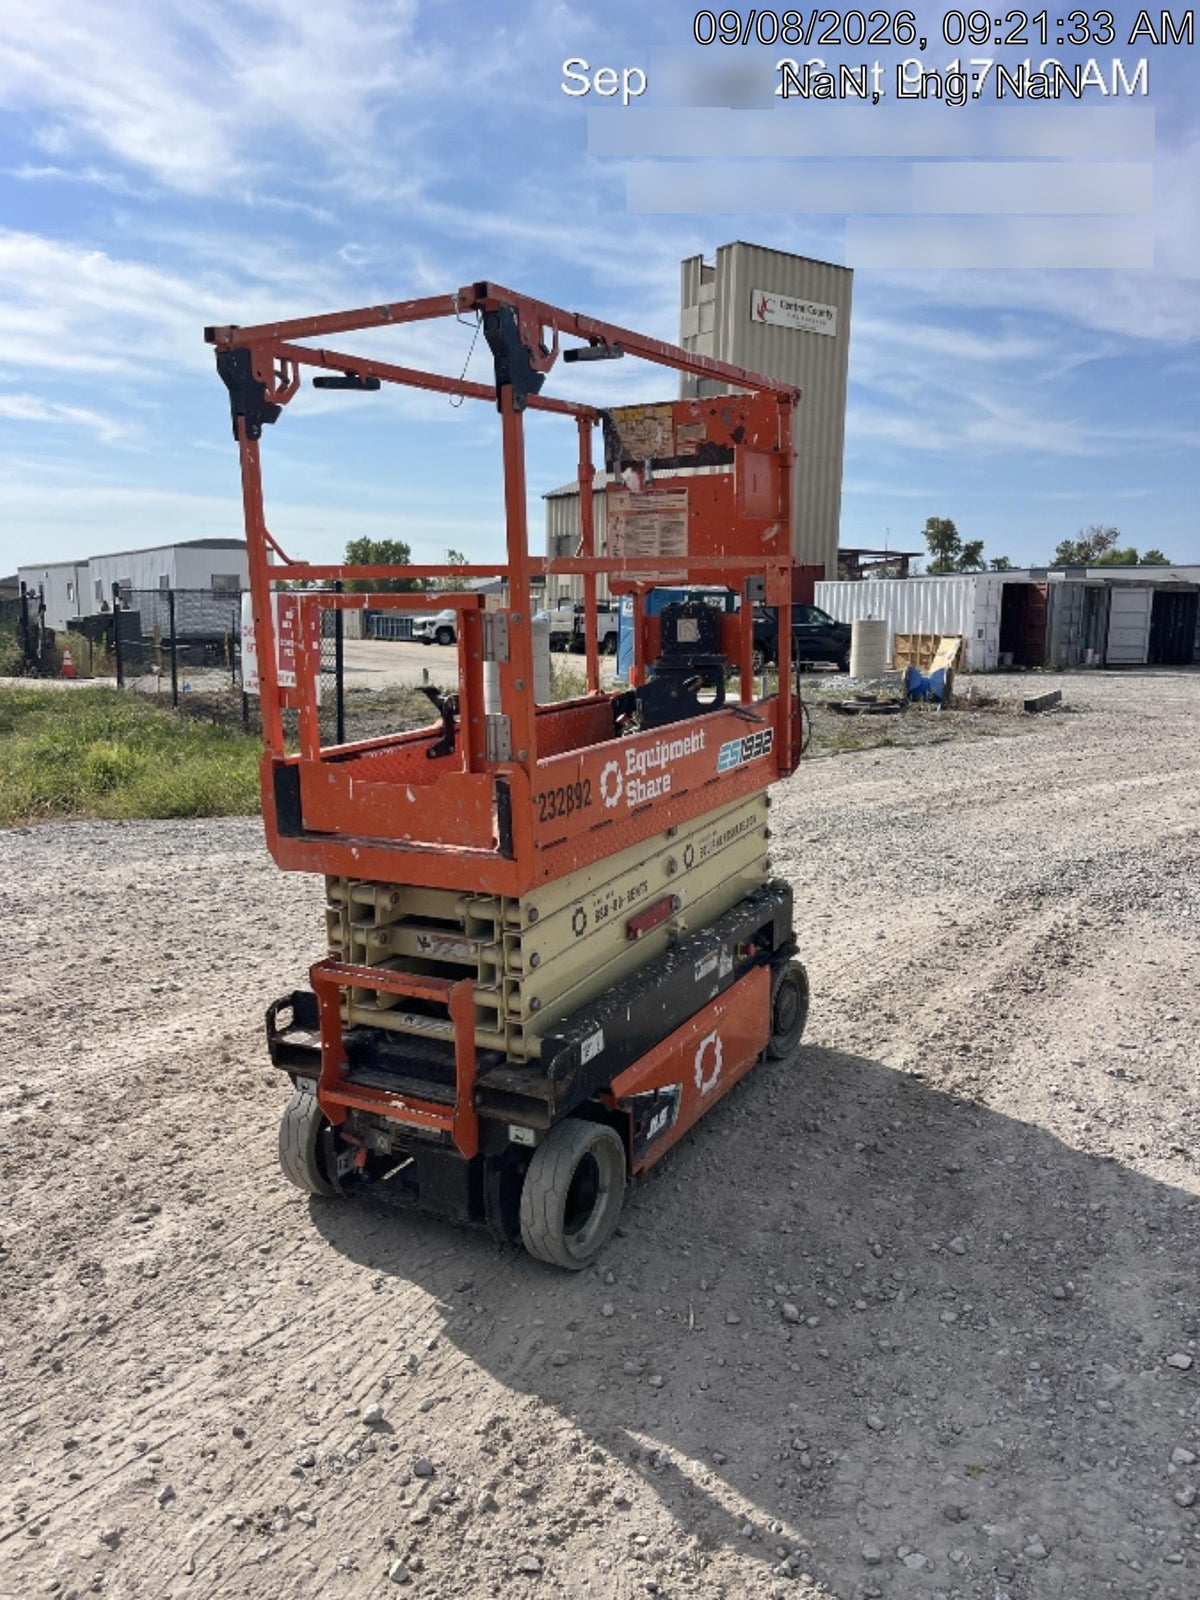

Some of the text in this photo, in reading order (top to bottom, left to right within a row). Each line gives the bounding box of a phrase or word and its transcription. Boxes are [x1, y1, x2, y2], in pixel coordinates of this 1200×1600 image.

[625, 728, 706, 775] Equipment
[539, 778, 592, 822] 232892
[626, 773, 672, 807] Share
